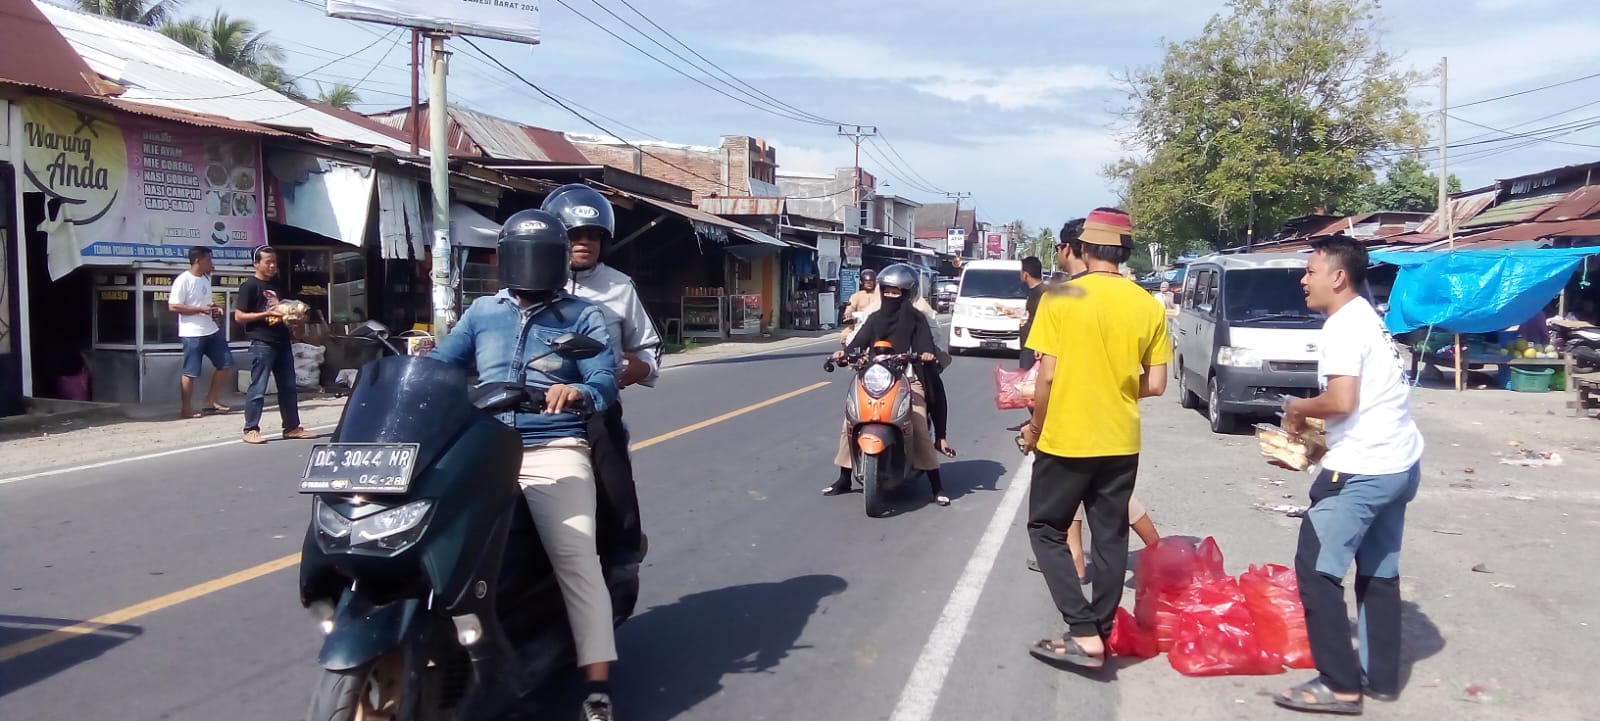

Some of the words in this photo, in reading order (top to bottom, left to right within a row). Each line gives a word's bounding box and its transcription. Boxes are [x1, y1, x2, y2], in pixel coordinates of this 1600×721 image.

[494, 0, 518, 9] BARAT
[521, 4, 539, 12] 2024
[24, 121, 92, 161] Warung
[143, 143, 160, 155] MIE
[160, 146, 182, 158] AYAM
[46, 152, 108, 190] Anda
[143, 157, 160, 169] MIE
[161, 160, 193, 172] GORENG
[144, 171, 165, 183] NASI
[166, 174, 199, 186] GORENG
[144, 184, 165, 196] NASI
[166, 187, 201, 200] CAMPUR
[145, 198, 194, 212] GADO-GADO
[232, 231, 248, 240] KOPI
[101, 291, 128, 300] BAKSO
[153, 291, 170, 301] BAK
